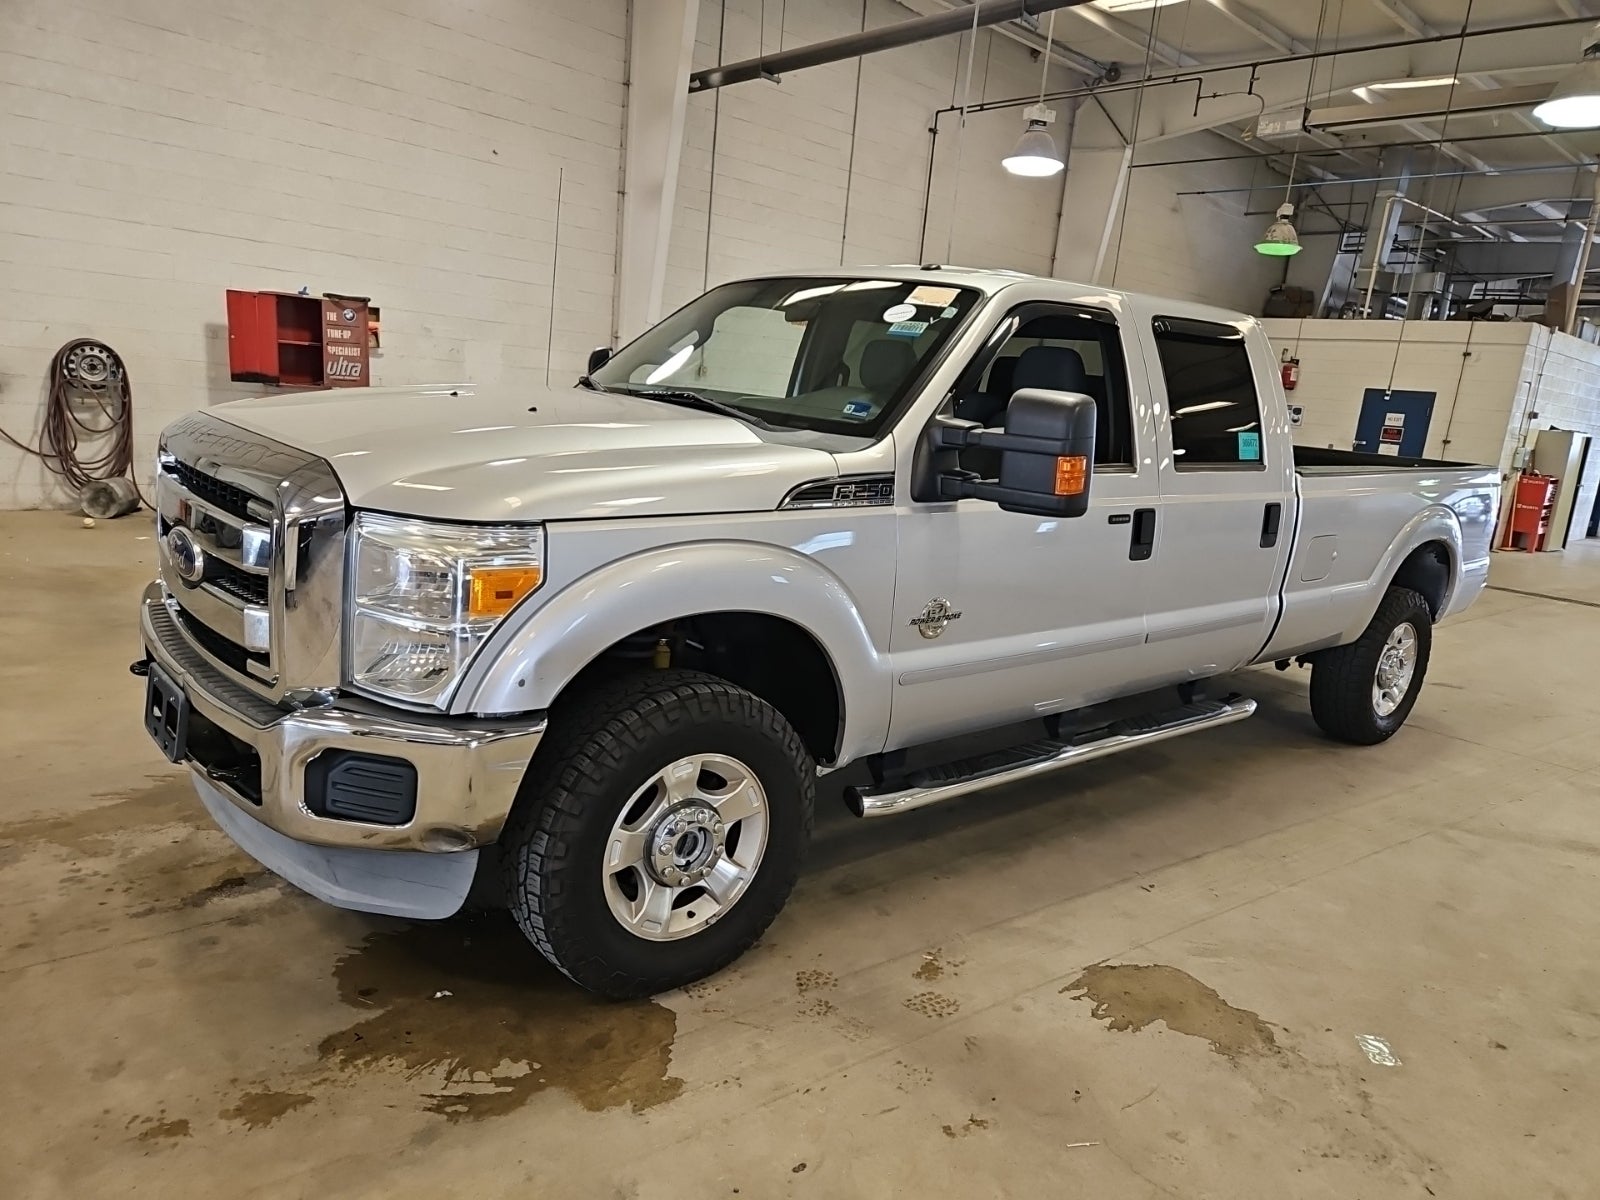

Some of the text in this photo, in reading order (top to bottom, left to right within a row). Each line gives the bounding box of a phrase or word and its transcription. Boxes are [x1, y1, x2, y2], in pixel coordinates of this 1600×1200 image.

[326, 311, 337, 321] THE
[327, 328, 351, 339] TUNE-UP
[327, 345, 360, 357] SPECIALIST
[326, 356, 362, 377] ultra
